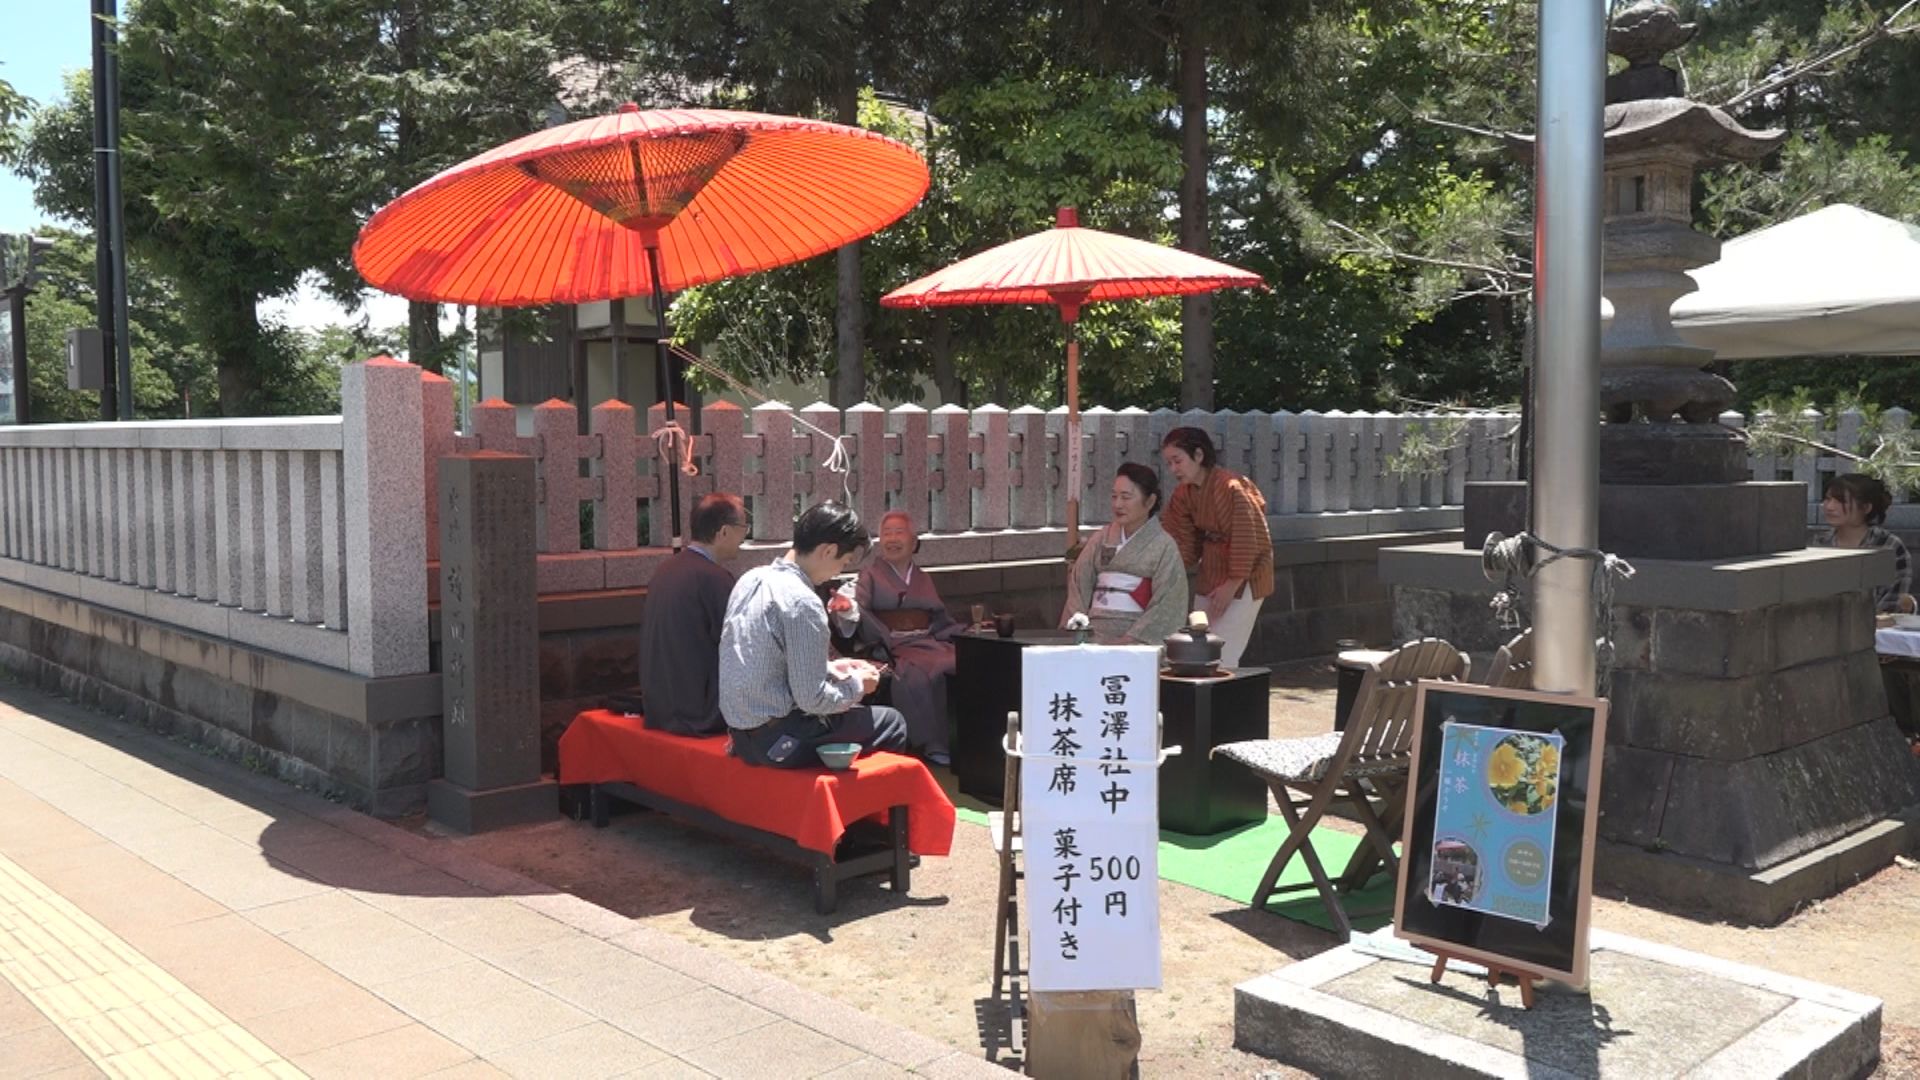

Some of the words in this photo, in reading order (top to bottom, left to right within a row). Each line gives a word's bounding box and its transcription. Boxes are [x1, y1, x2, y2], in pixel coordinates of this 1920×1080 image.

[1047, 692, 1083, 796] 抹茶席
[1052, 827, 1083, 960] 菓子付き
